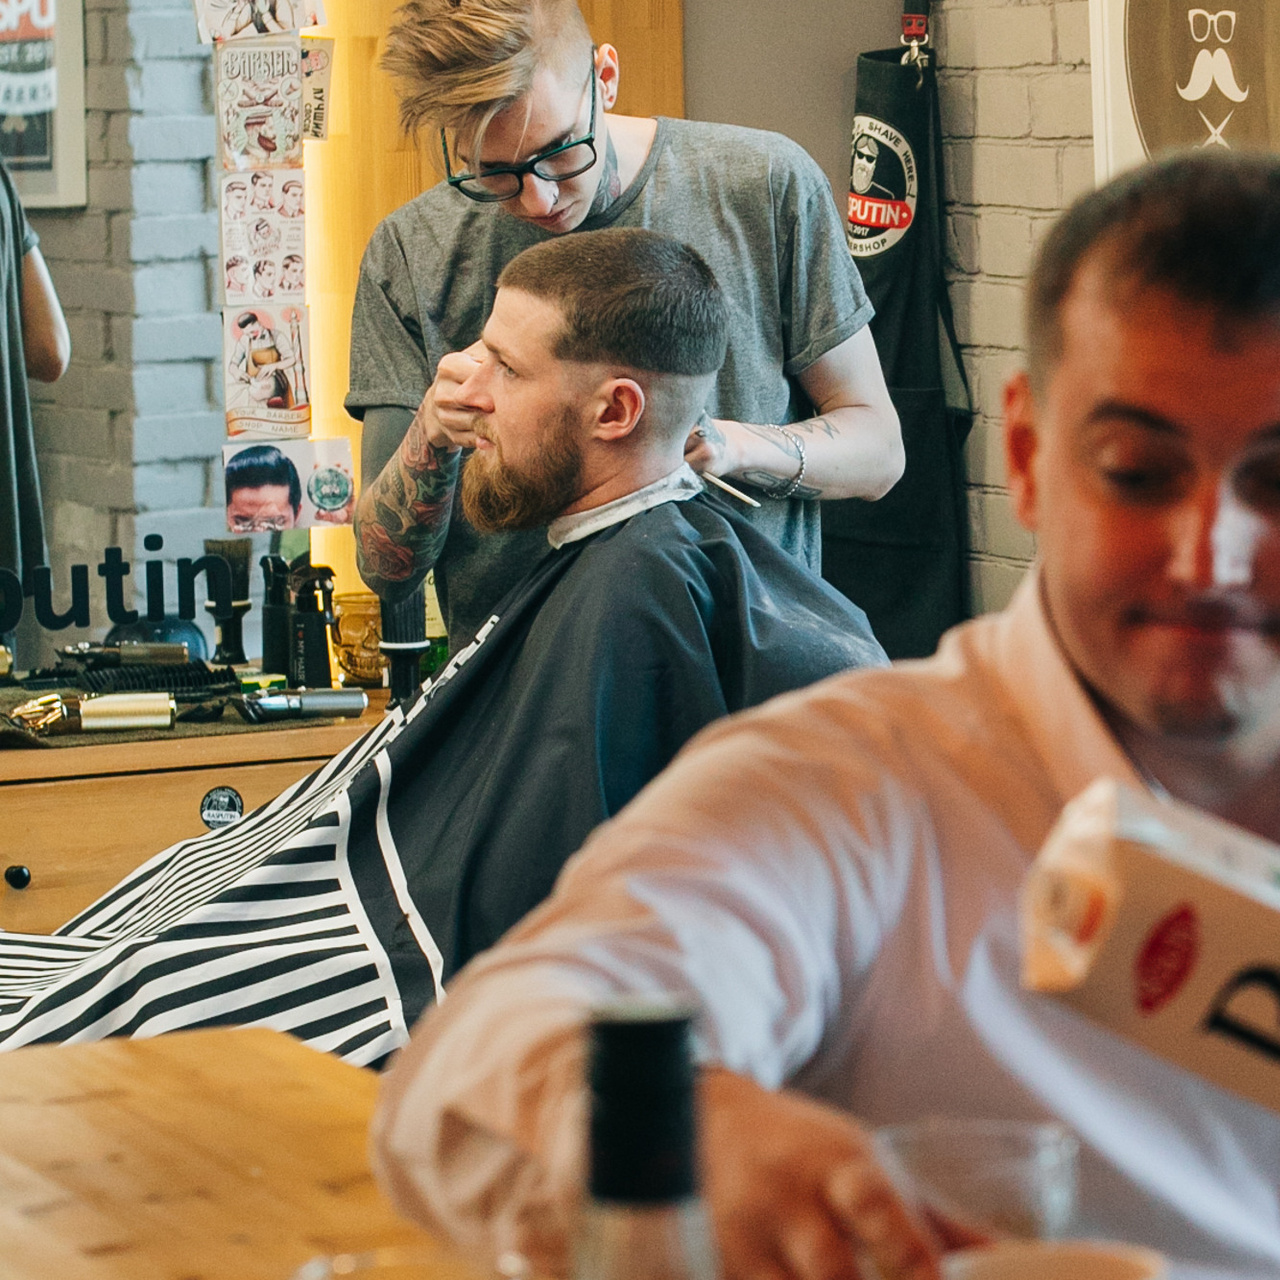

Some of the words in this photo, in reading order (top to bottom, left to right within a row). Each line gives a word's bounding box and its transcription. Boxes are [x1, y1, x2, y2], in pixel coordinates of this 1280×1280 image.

[224, 50, 298, 80] BARBER
[311, 87, 325, 138] ЛУЧШИЙ
[868, 121, 902, 148] SHAVE
[902, 150, 915, 182] HERE
